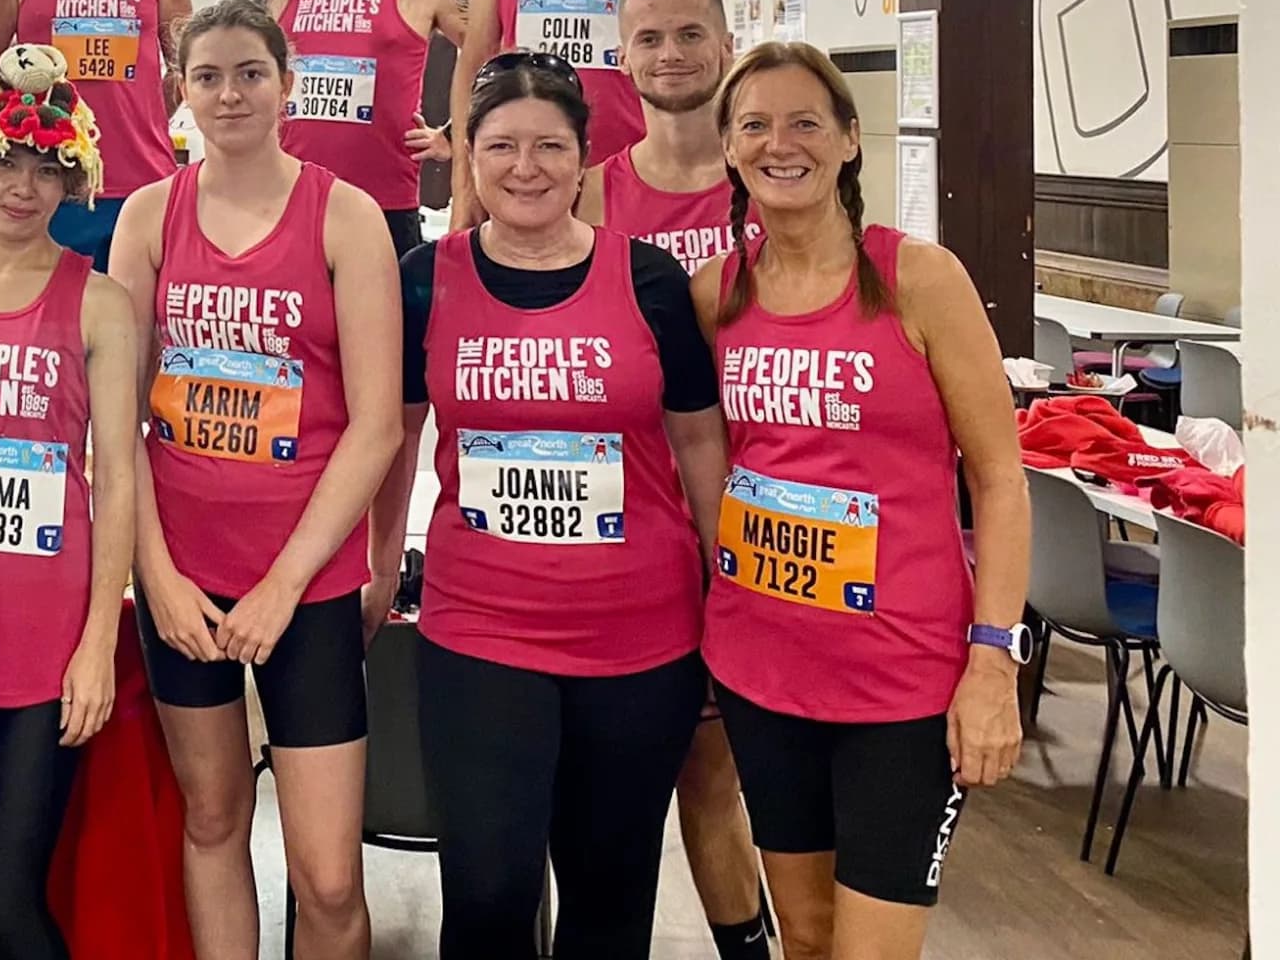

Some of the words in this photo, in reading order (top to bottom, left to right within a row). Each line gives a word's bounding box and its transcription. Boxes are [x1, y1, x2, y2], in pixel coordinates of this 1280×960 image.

[56, 0, 118, 18] KITCHEN
[292, 13, 354, 33] KITCHEN
[543, 18, 591, 39] COLIN
[86, 38, 109, 56] LEE
[79, 58, 115, 77] 5428
[302, 76, 353, 97] STEVEN
[302, 97, 348, 118] 30764
[166, 281, 187, 317] THE
[186, 283, 303, 328] PEOPLE'S
[167, 316, 263, 353] KITCHEN
[456, 336, 484, 367] THE
[486, 336, 612, 369] PEOPLE'S
[456, 367, 570, 401] KITCHEN
[723, 346, 744, 382] THE
[741, 346, 875, 393] PEOPLE'S
[185, 382, 262, 420] KARIM
[573, 378, 604, 395] 1985
[21, 394, 50, 413] 1985
[723, 383, 823, 427] KITCHEN
[825, 403, 860, 422] 1985
[184, 418, 258, 455] 15260
[540, 439, 567, 449] north
[492, 467, 588, 501] JOANNE
[785, 493, 815, 505] north
[500, 503, 583, 538] 32882
[743, 510, 837, 564] MAGGIE
[753, 551, 817, 600] 7122
[926, 782, 962, 887] DKNY
